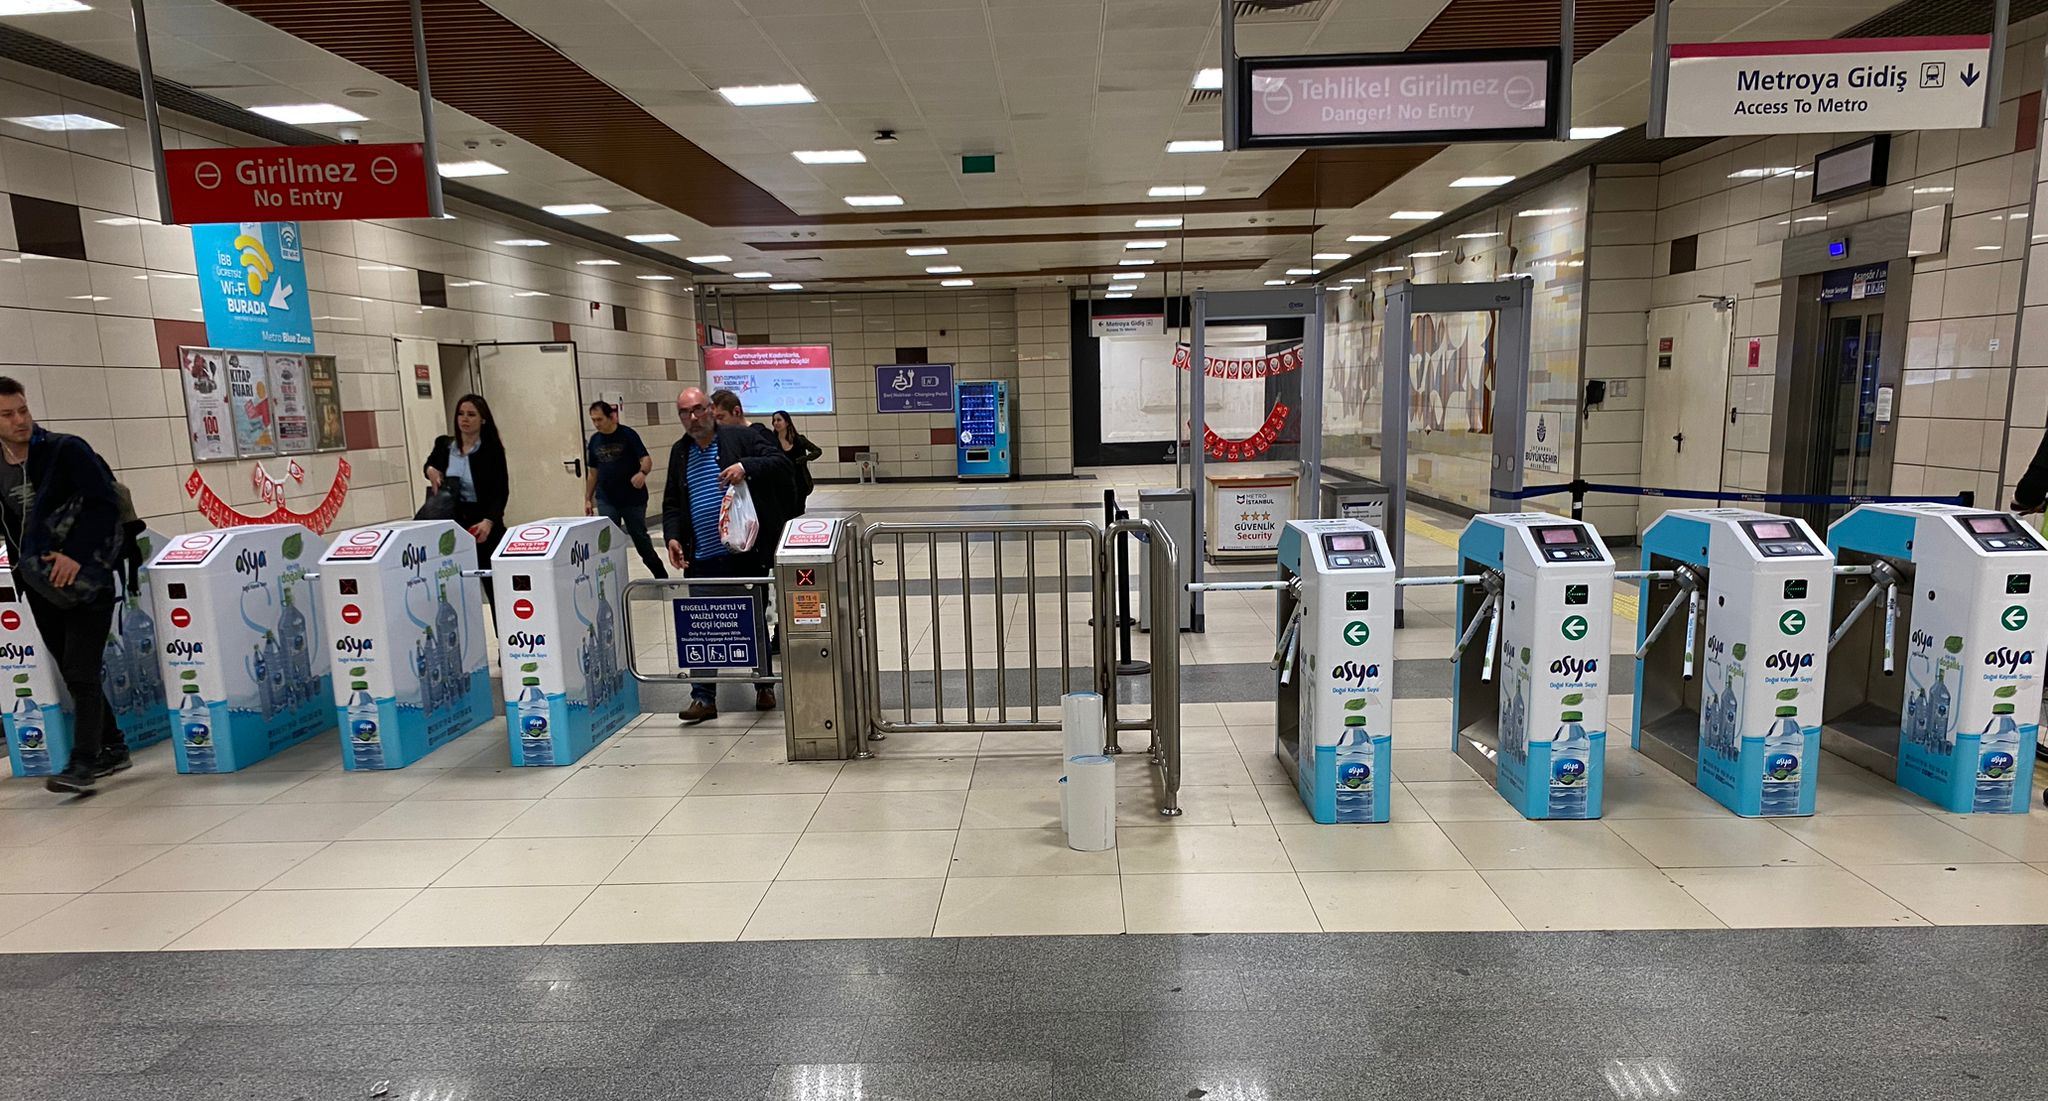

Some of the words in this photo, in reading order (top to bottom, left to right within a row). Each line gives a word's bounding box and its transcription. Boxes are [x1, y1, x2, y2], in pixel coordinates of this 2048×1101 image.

[1298, 76, 1390, 100] Tehlike!
[1400, 74, 1499, 98] Girilmez
[1737, 70, 1839, 94] Metroya
[1848, 66, 1908, 92] Gidiş
[1322, 104, 1391, 124] Danger!
[1399, 103, 1422, 120] No
[1428, 102, 1474, 121] Entry
[1734, 101, 1788, 114] Access
[1794, 100, 1812, 113] To
[1818, 98, 1868, 112] Metro
[236, 158, 357, 185] Girilmez
[254, 190, 282, 207] No
[289, 188, 343, 210] Entry
[218, 250, 232, 266] İBB
[220, 280, 247, 296] Wi-Fi
[227, 298, 268, 315] BURADA
[262, 331, 282, 342] Metro
[282, 332, 296, 343] Blue
[297, 333, 311, 344] Zone
[204, 416, 219, 434] 100
[1525, 450, 1558, 466] BÜYÜKŞEHİR
[1234, 522, 1276, 531] GÜVENLİK
[1238, 532, 1272, 541] Security
[236, 548, 267, 582] asya
[402, 543, 427, 577] asya
[571, 540, 590, 574] asya
[714, 621, 738, 629] İÇİNDİR
[166, 639, 202, 661] asya
[336, 636, 373, 658] asya
[508, 631, 546, 654] asya
[1912, 629, 1933, 654] asya
[1550, 656, 1597, 682] asya
[1766, 650, 1813, 677] asya
[1984, 646, 2032, 674] asya
[1332, 660, 1378, 688] asya
